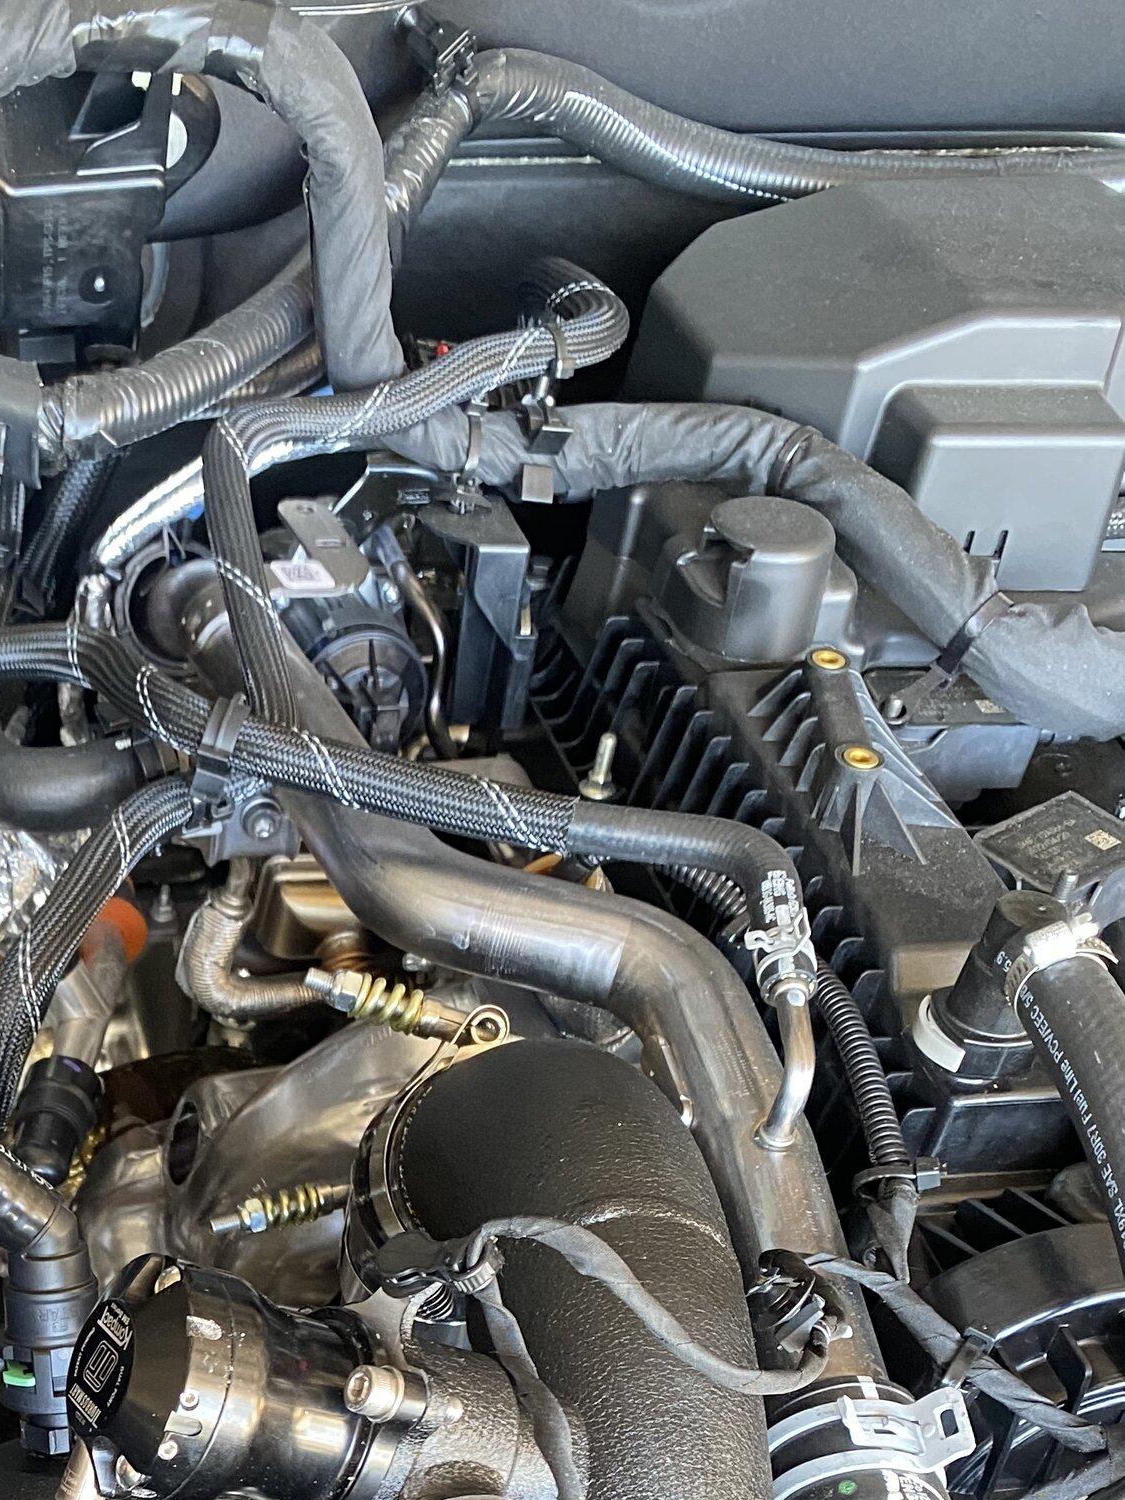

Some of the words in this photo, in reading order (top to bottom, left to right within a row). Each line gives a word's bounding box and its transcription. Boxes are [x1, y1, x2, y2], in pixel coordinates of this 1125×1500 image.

[1060, 1061, 1079, 1096] Line
[1074, 1093, 1093, 1126] Fuel
[1086, 1127, 1108, 1165] 30R7
[1100, 1164, 1119, 1198] SAE
